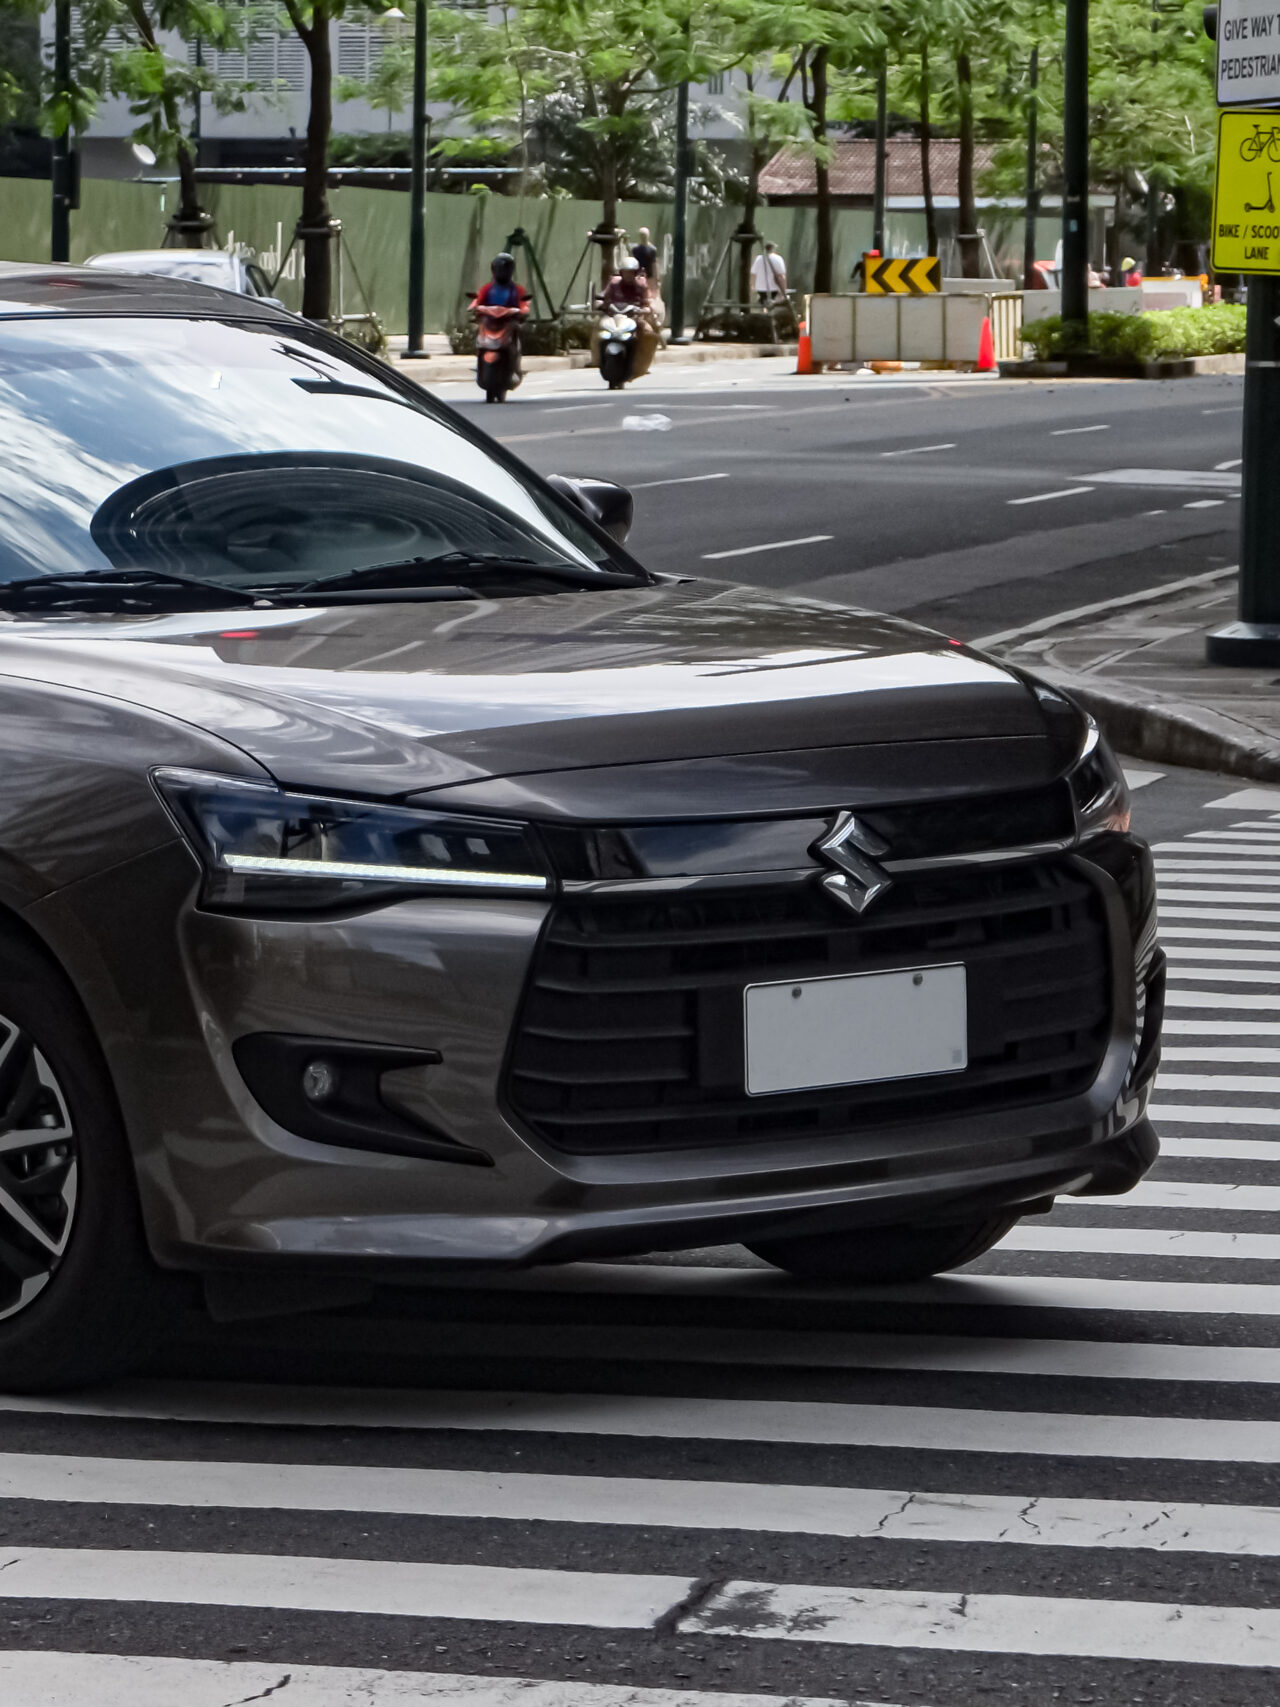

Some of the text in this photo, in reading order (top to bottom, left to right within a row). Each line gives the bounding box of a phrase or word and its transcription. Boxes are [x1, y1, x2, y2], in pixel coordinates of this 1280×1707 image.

[1224, 18, 1248, 41] GIVE
[1251, 15, 1274, 38] WAY
[1219, 224, 1280, 239] BIKE / SCOO
[1244, 246, 1270, 260] LANE
